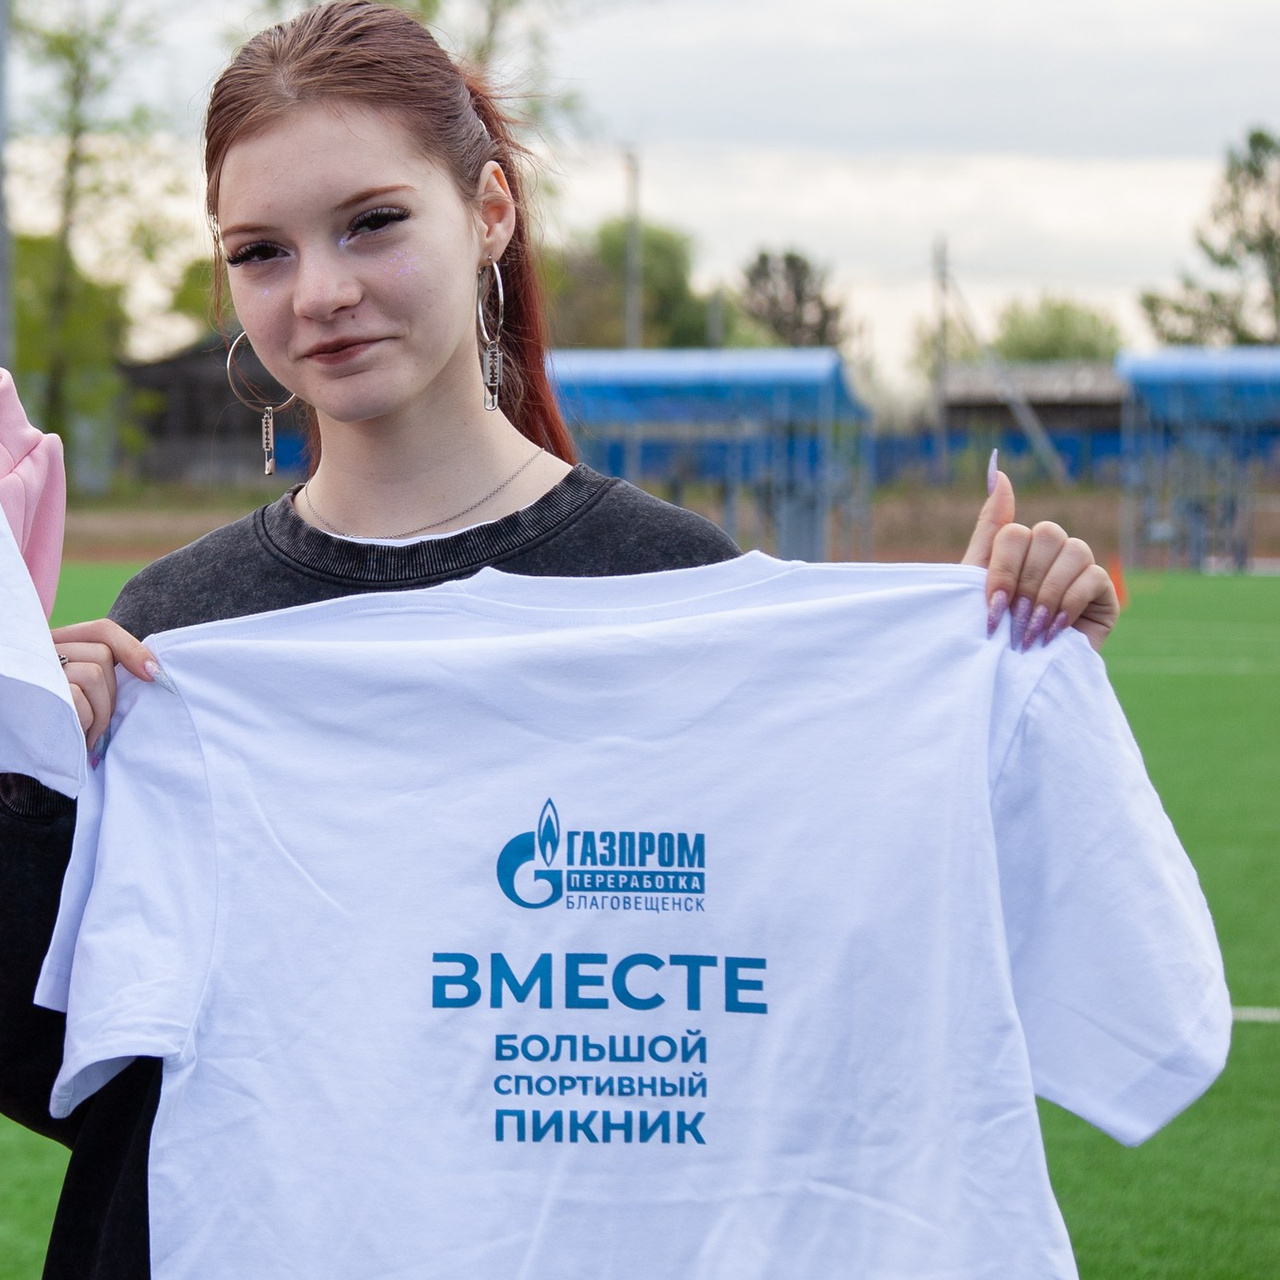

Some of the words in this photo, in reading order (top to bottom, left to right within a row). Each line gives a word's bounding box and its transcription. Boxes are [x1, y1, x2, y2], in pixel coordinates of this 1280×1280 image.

[566, 831, 705, 868] ГАЗПРОМ
[570, 873, 701, 890] ПЕРЕРАБОТКА
[566, 895, 705, 914] БЛАГОВЕЩЕНСК
[432, 952, 768, 1014] ВМЕСТЕ
[495, 1029, 706, 1063] БОЛЬШОЙ
[493, 1072, 707, 1098] СПОРТИВНЫЙ
[495, 1109, 707, 1145] ПИКНИК
